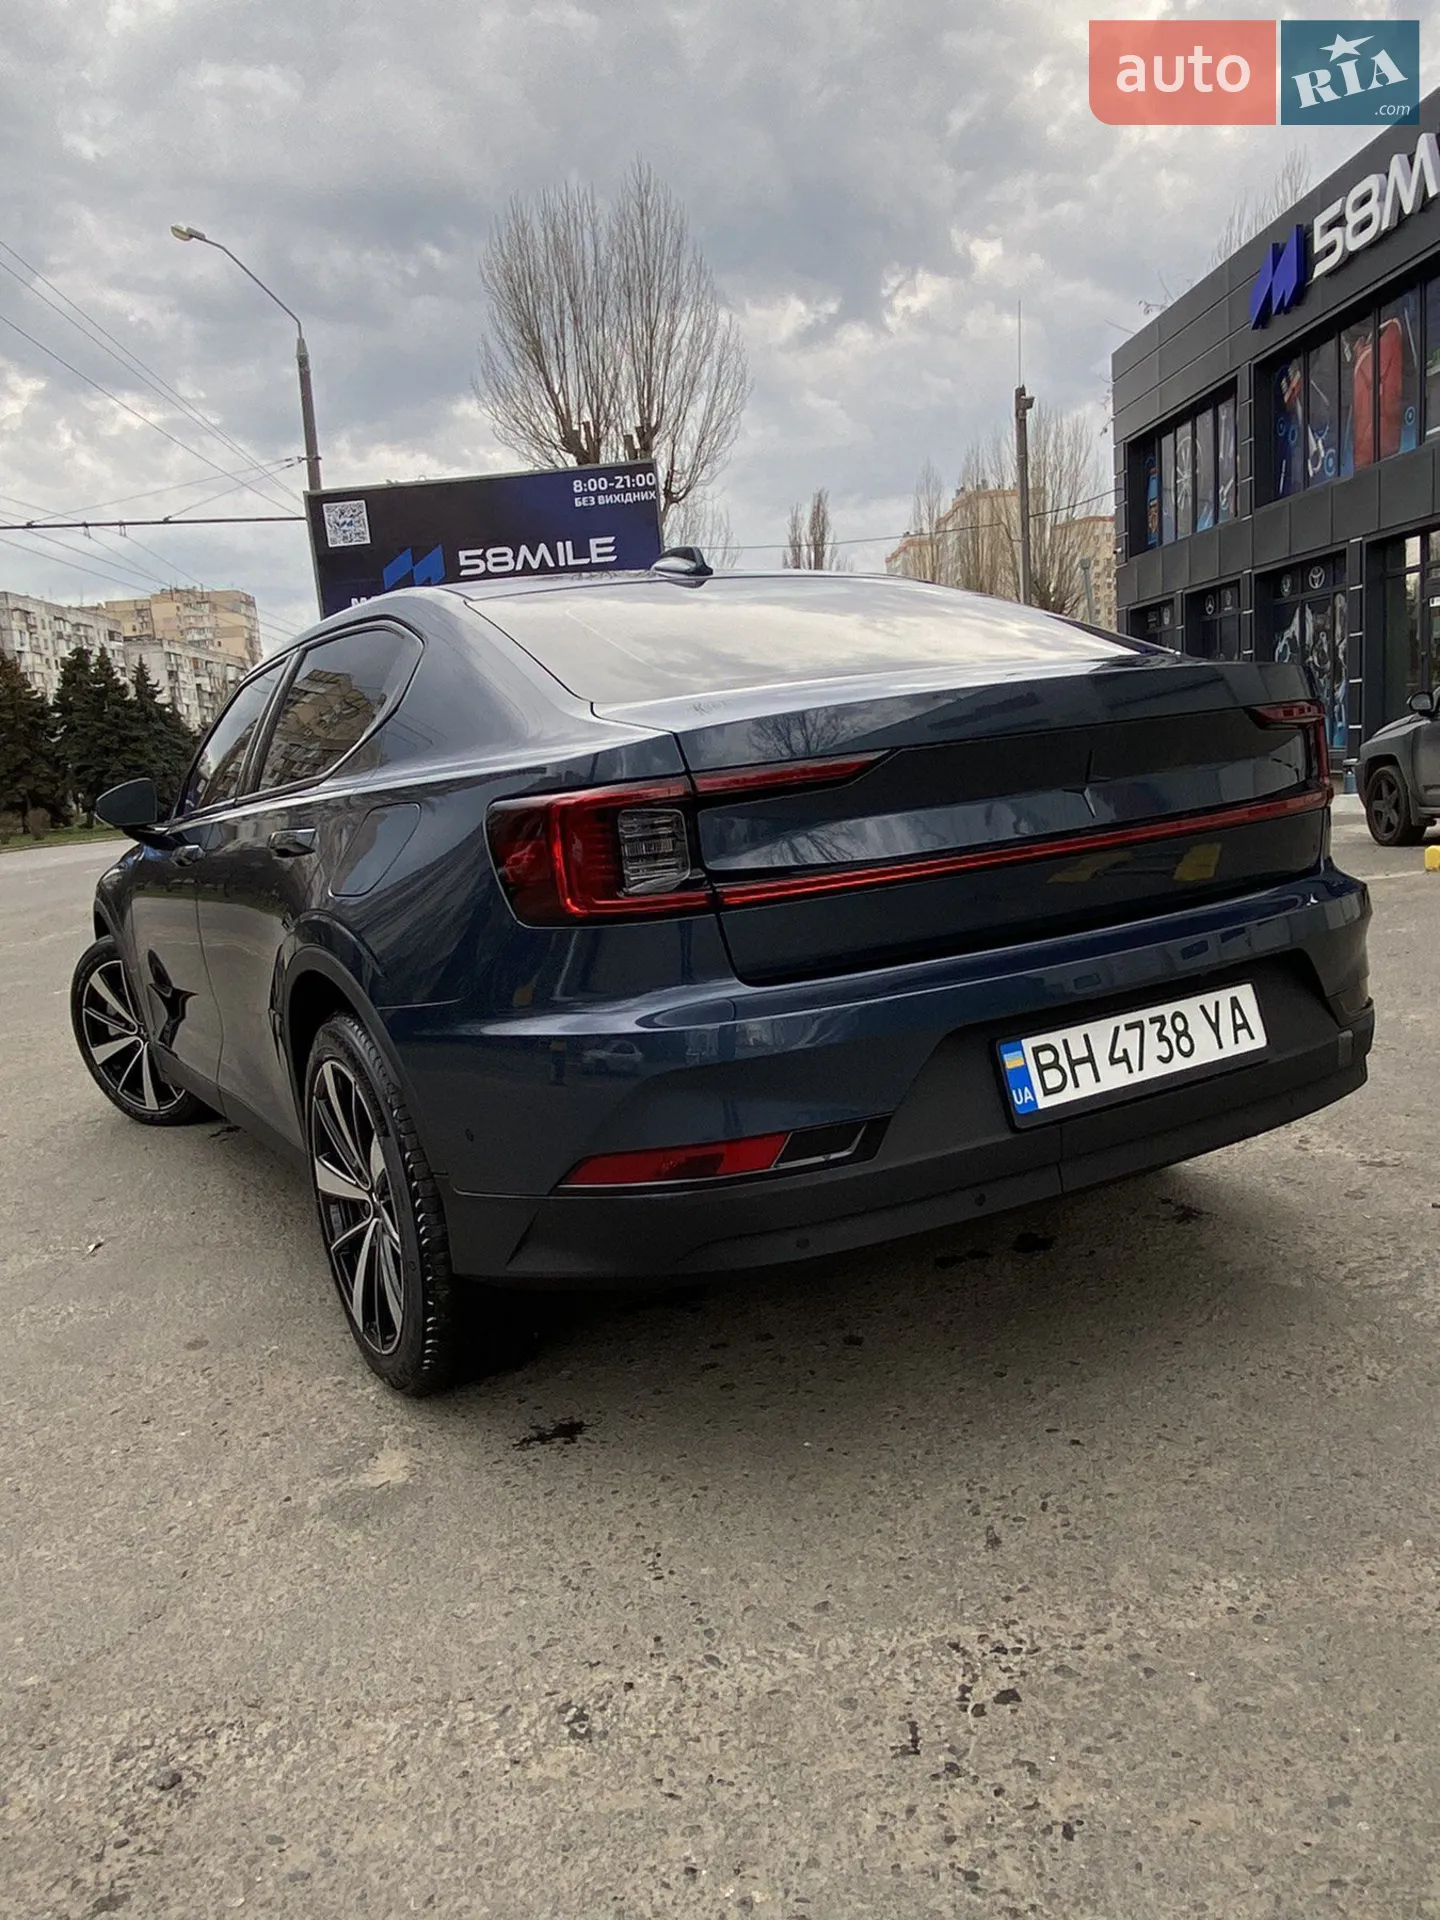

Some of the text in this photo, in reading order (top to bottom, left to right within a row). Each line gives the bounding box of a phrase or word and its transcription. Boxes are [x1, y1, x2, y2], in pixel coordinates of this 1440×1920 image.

[572, 472, 656, 494] 8:00-21:00
[574, 490, 657, 508] БЕЗ ВИХІДНИХ
[458, 536, 617, 577] 58MILE
[1031, 996, 1255, 1097] BH 4738 YA
[1012, 1086, 1035, 1106] UA
